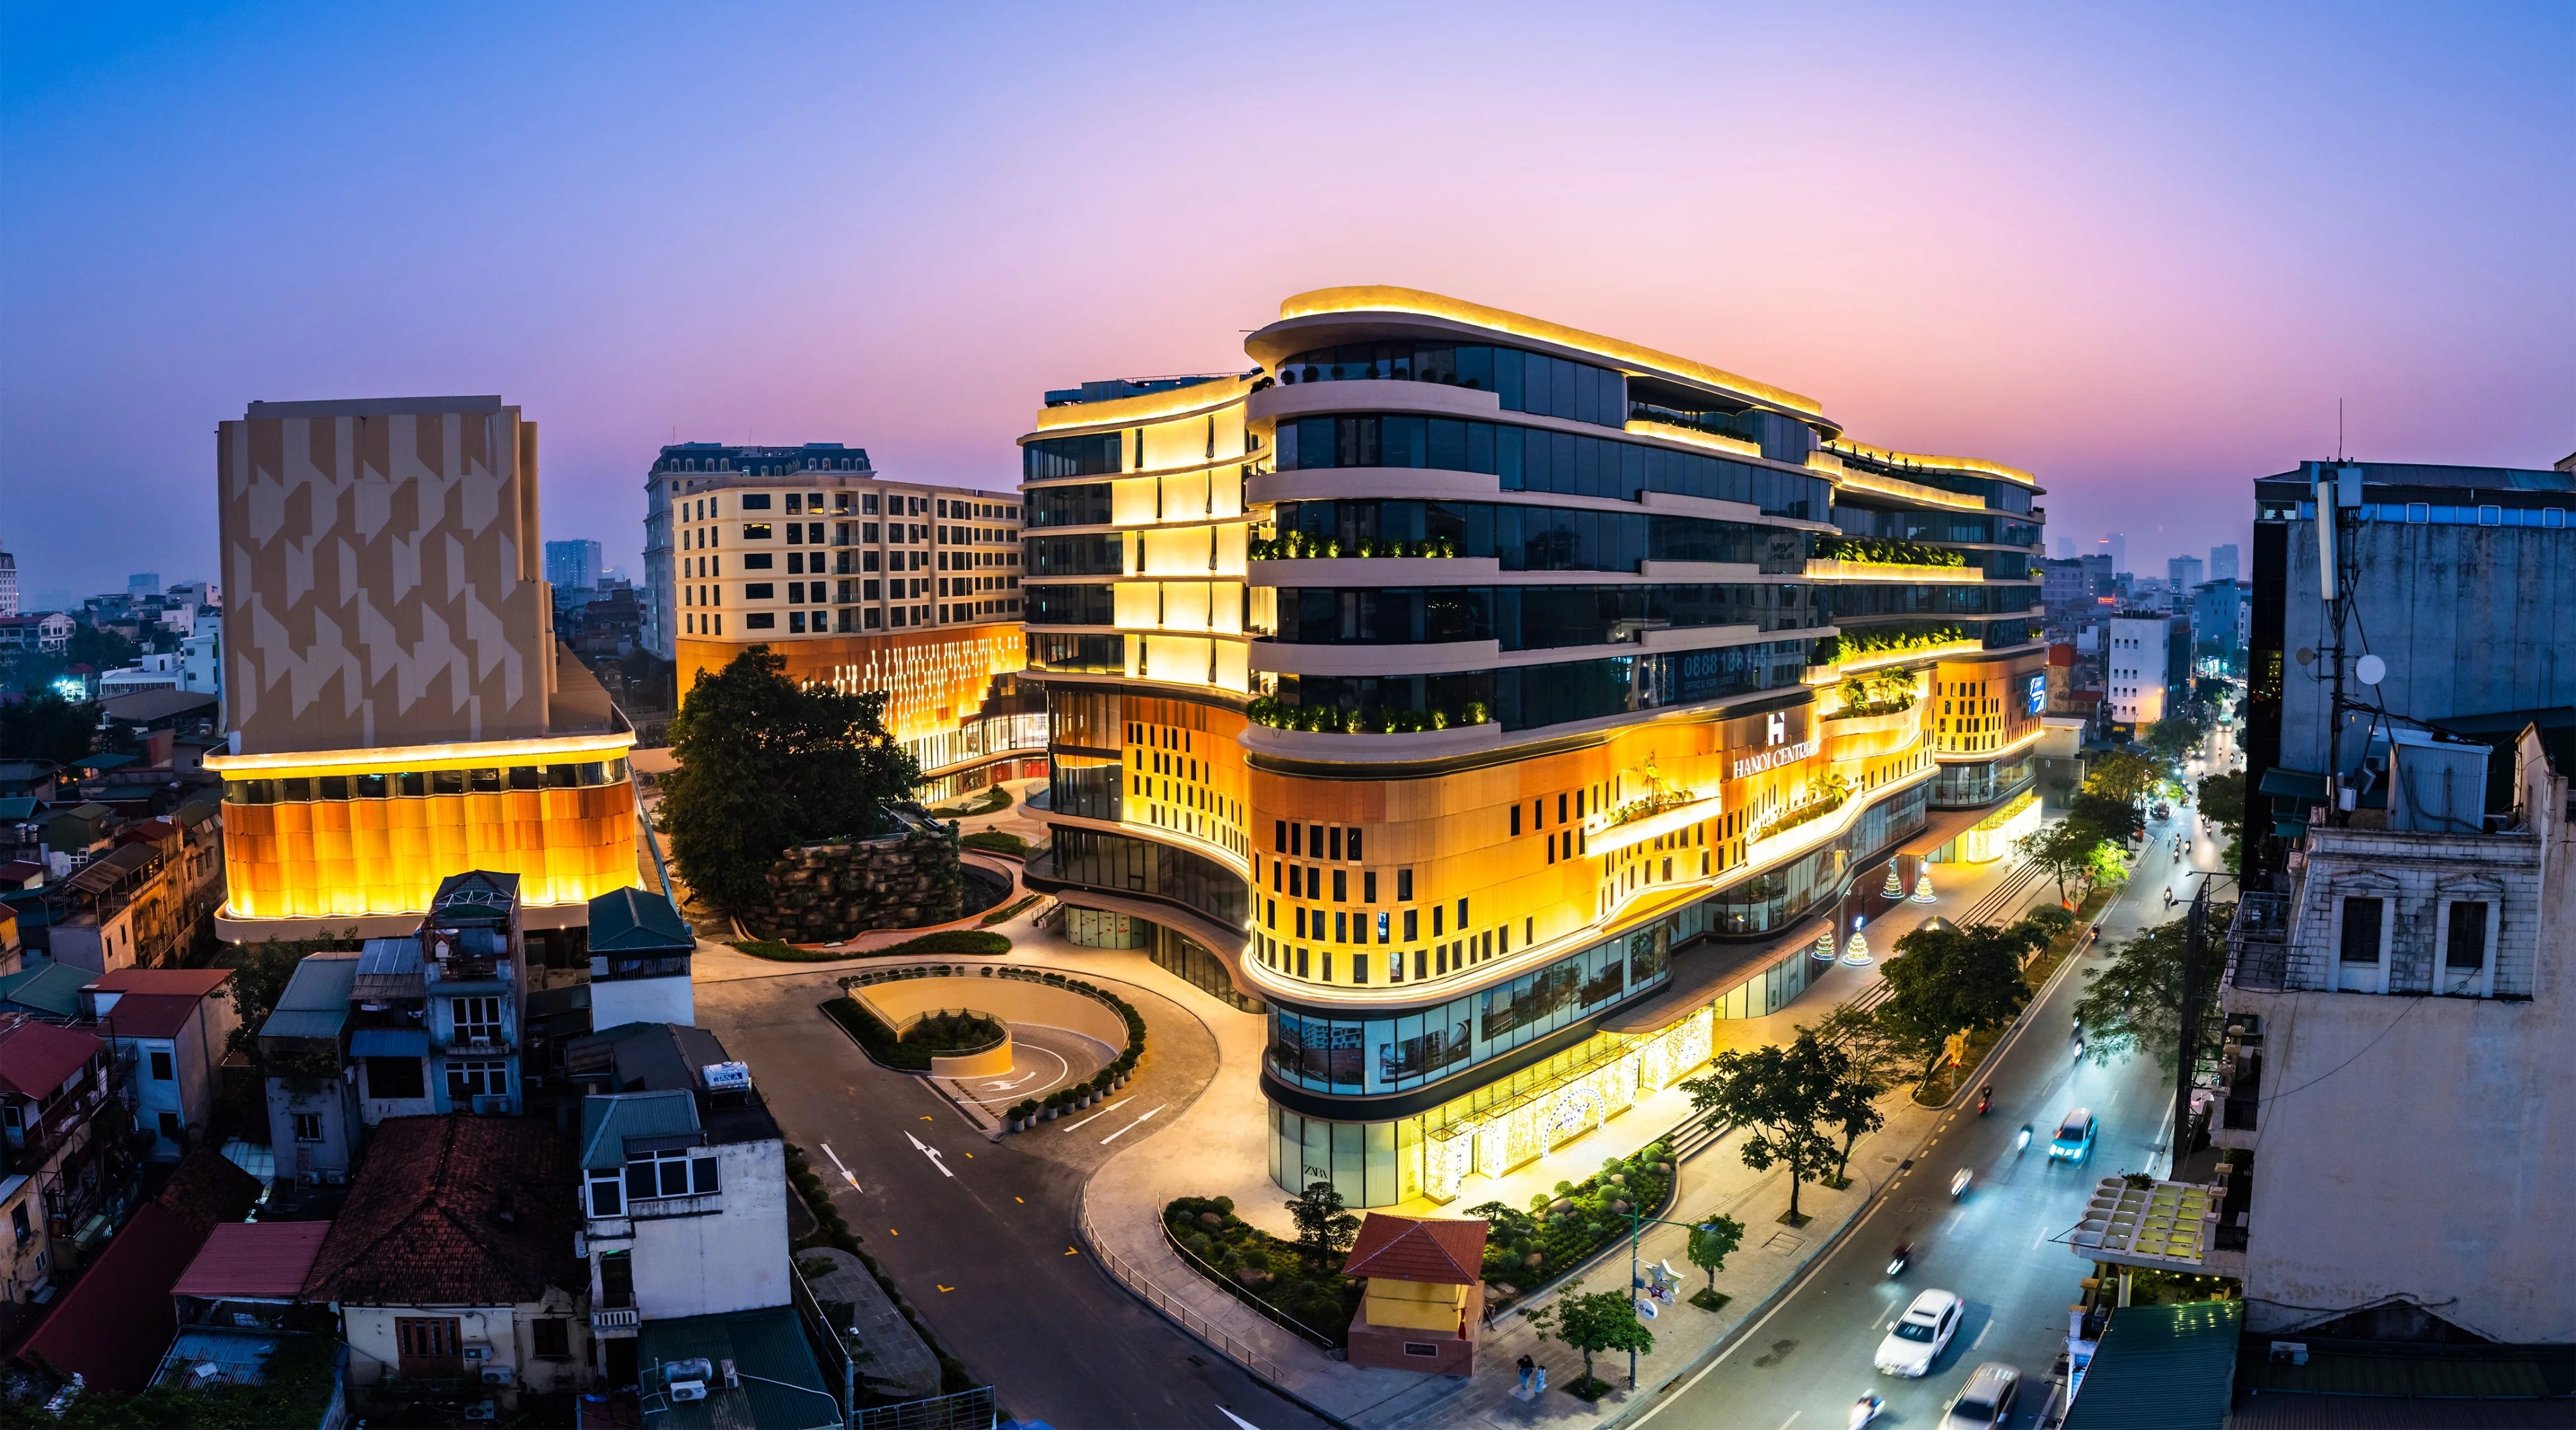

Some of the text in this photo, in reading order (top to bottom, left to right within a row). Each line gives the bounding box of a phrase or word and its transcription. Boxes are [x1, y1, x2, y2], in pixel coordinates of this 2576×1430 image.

[1684, 653, 1718, 678] 0888
[1720, 651, 1743, 673] 188
[1684, 675, 1736, 691] OFFICE FOR LEASE
[1734, 741, 1812, 779] HANOI CENTRE
[1304, 1165, 1328, 1180] ZARA
